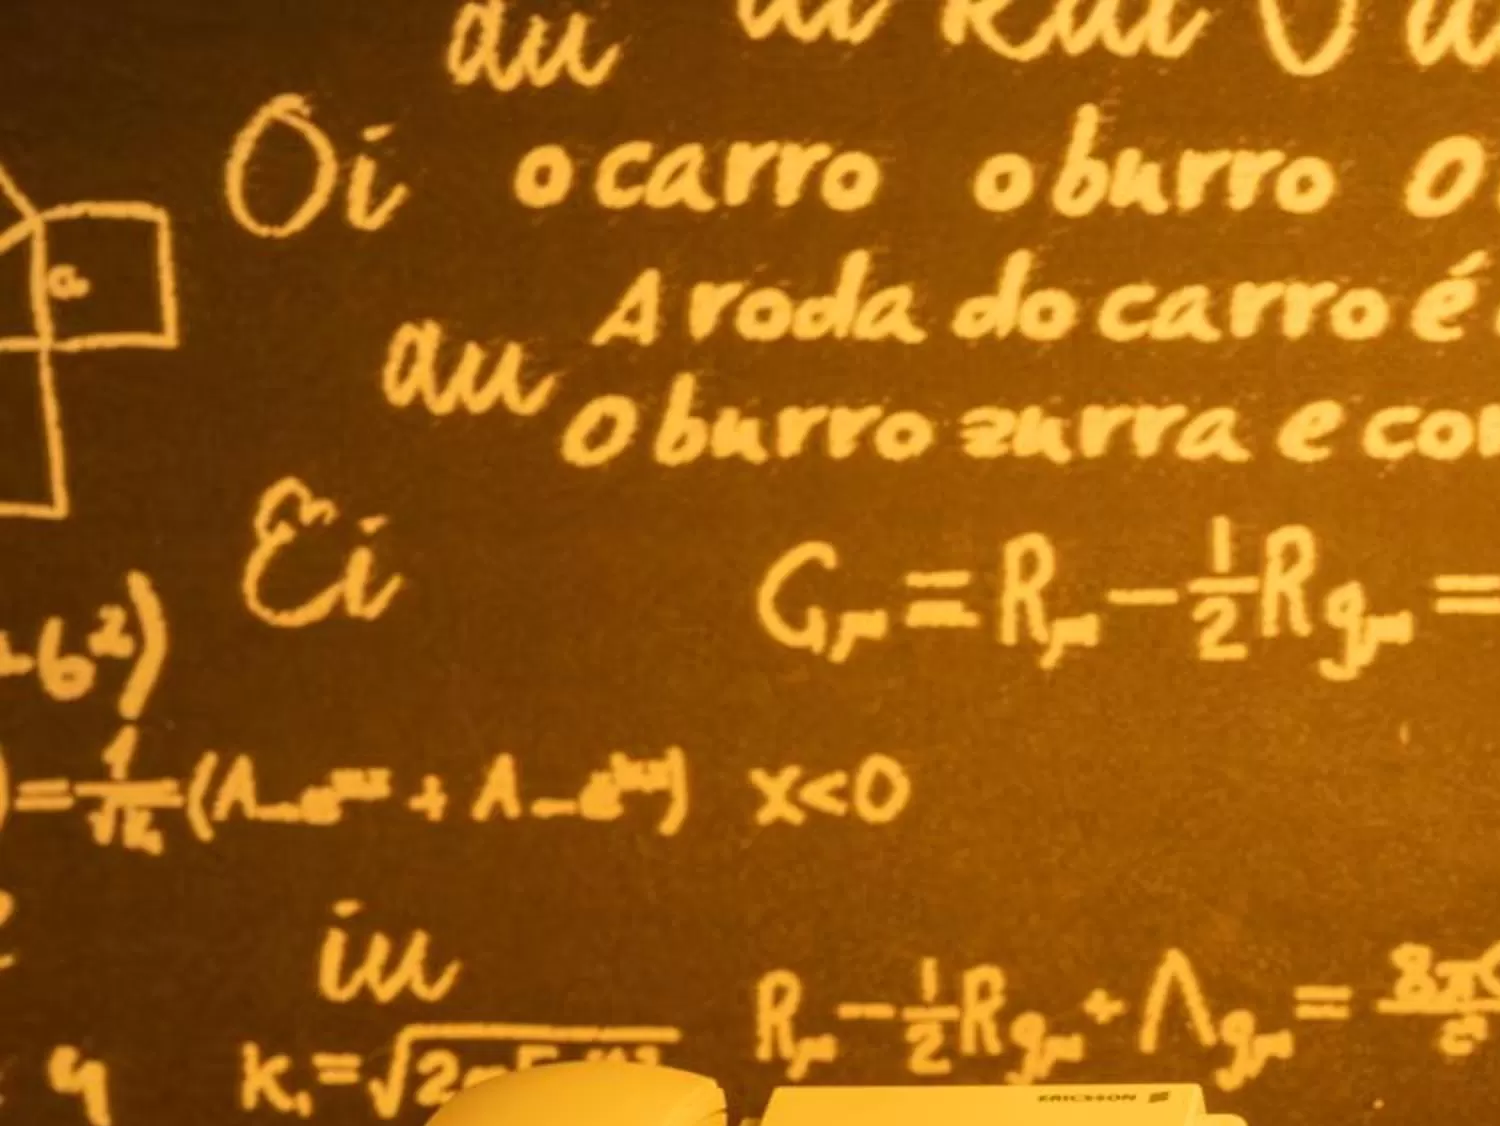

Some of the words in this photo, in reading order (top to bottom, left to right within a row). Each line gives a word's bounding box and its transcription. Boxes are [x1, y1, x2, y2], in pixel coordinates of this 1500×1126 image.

[514, 145, 573, 208] o
[594, 140, 881, 211] carro
[972, 152, 1034, 212] o
[1052, 102, 1336, 218] burro
[1405, 135, 1485, 218] O
[592, 268, 660, 346] A
[690, 250, 928, 343] roda
[952, 250, 1078, 340] do
[1100, 282, 1392, 342] carro
[1412, 250, 1490, 342] é
[562, 395, 638, 468] O
[655, 372, 933, 464] burro
[1277, 400, 1344, 464] e
